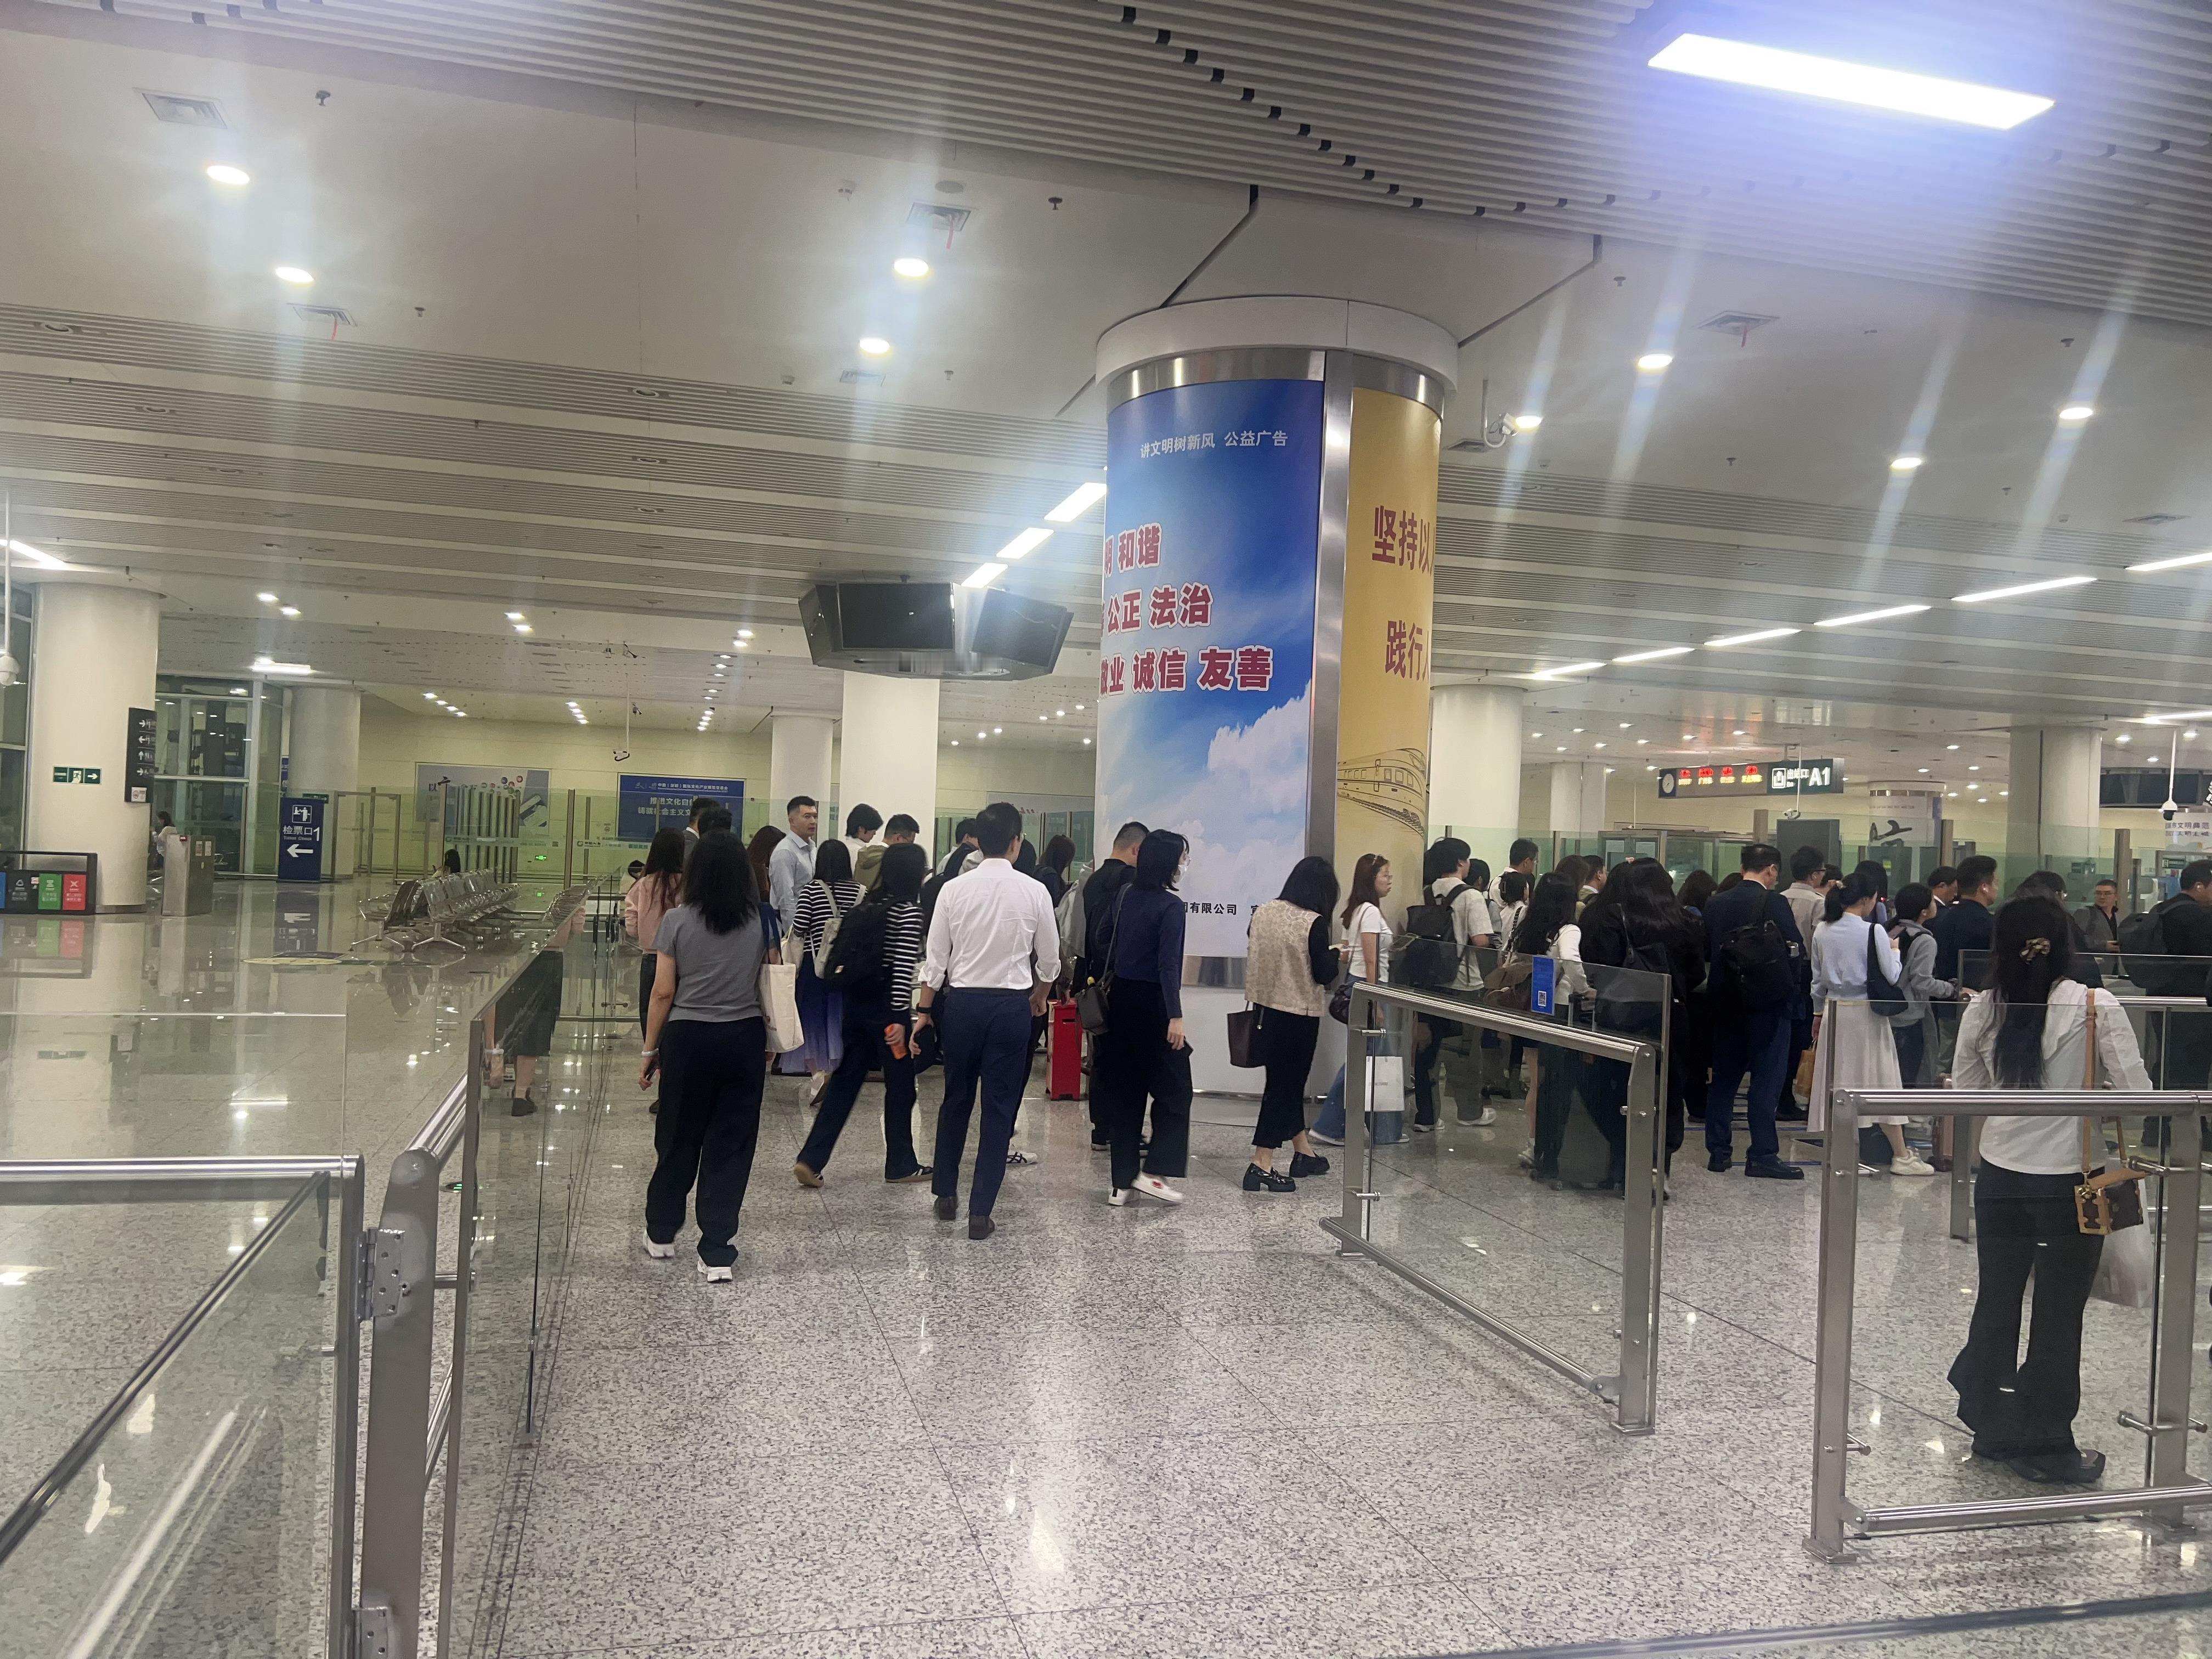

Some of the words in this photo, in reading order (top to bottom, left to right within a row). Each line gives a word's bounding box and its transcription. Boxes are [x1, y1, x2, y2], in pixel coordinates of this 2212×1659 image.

[1140, 433, 1215, 459] 讲文明树新风
[1224, 430, 1288, 447] 公益广告
[1119, 523, 1162, 573] 和谐
[1108, 589, 1142, 635] 公正
[1149, 582, 1214, 629] 法治
[1131, 647, 1188, 693] 诚信
[1197, 645, 1273, 692] 友善
[1809, 767, 1831, 786] A1
[283, 825, 313, 835] 检票口
